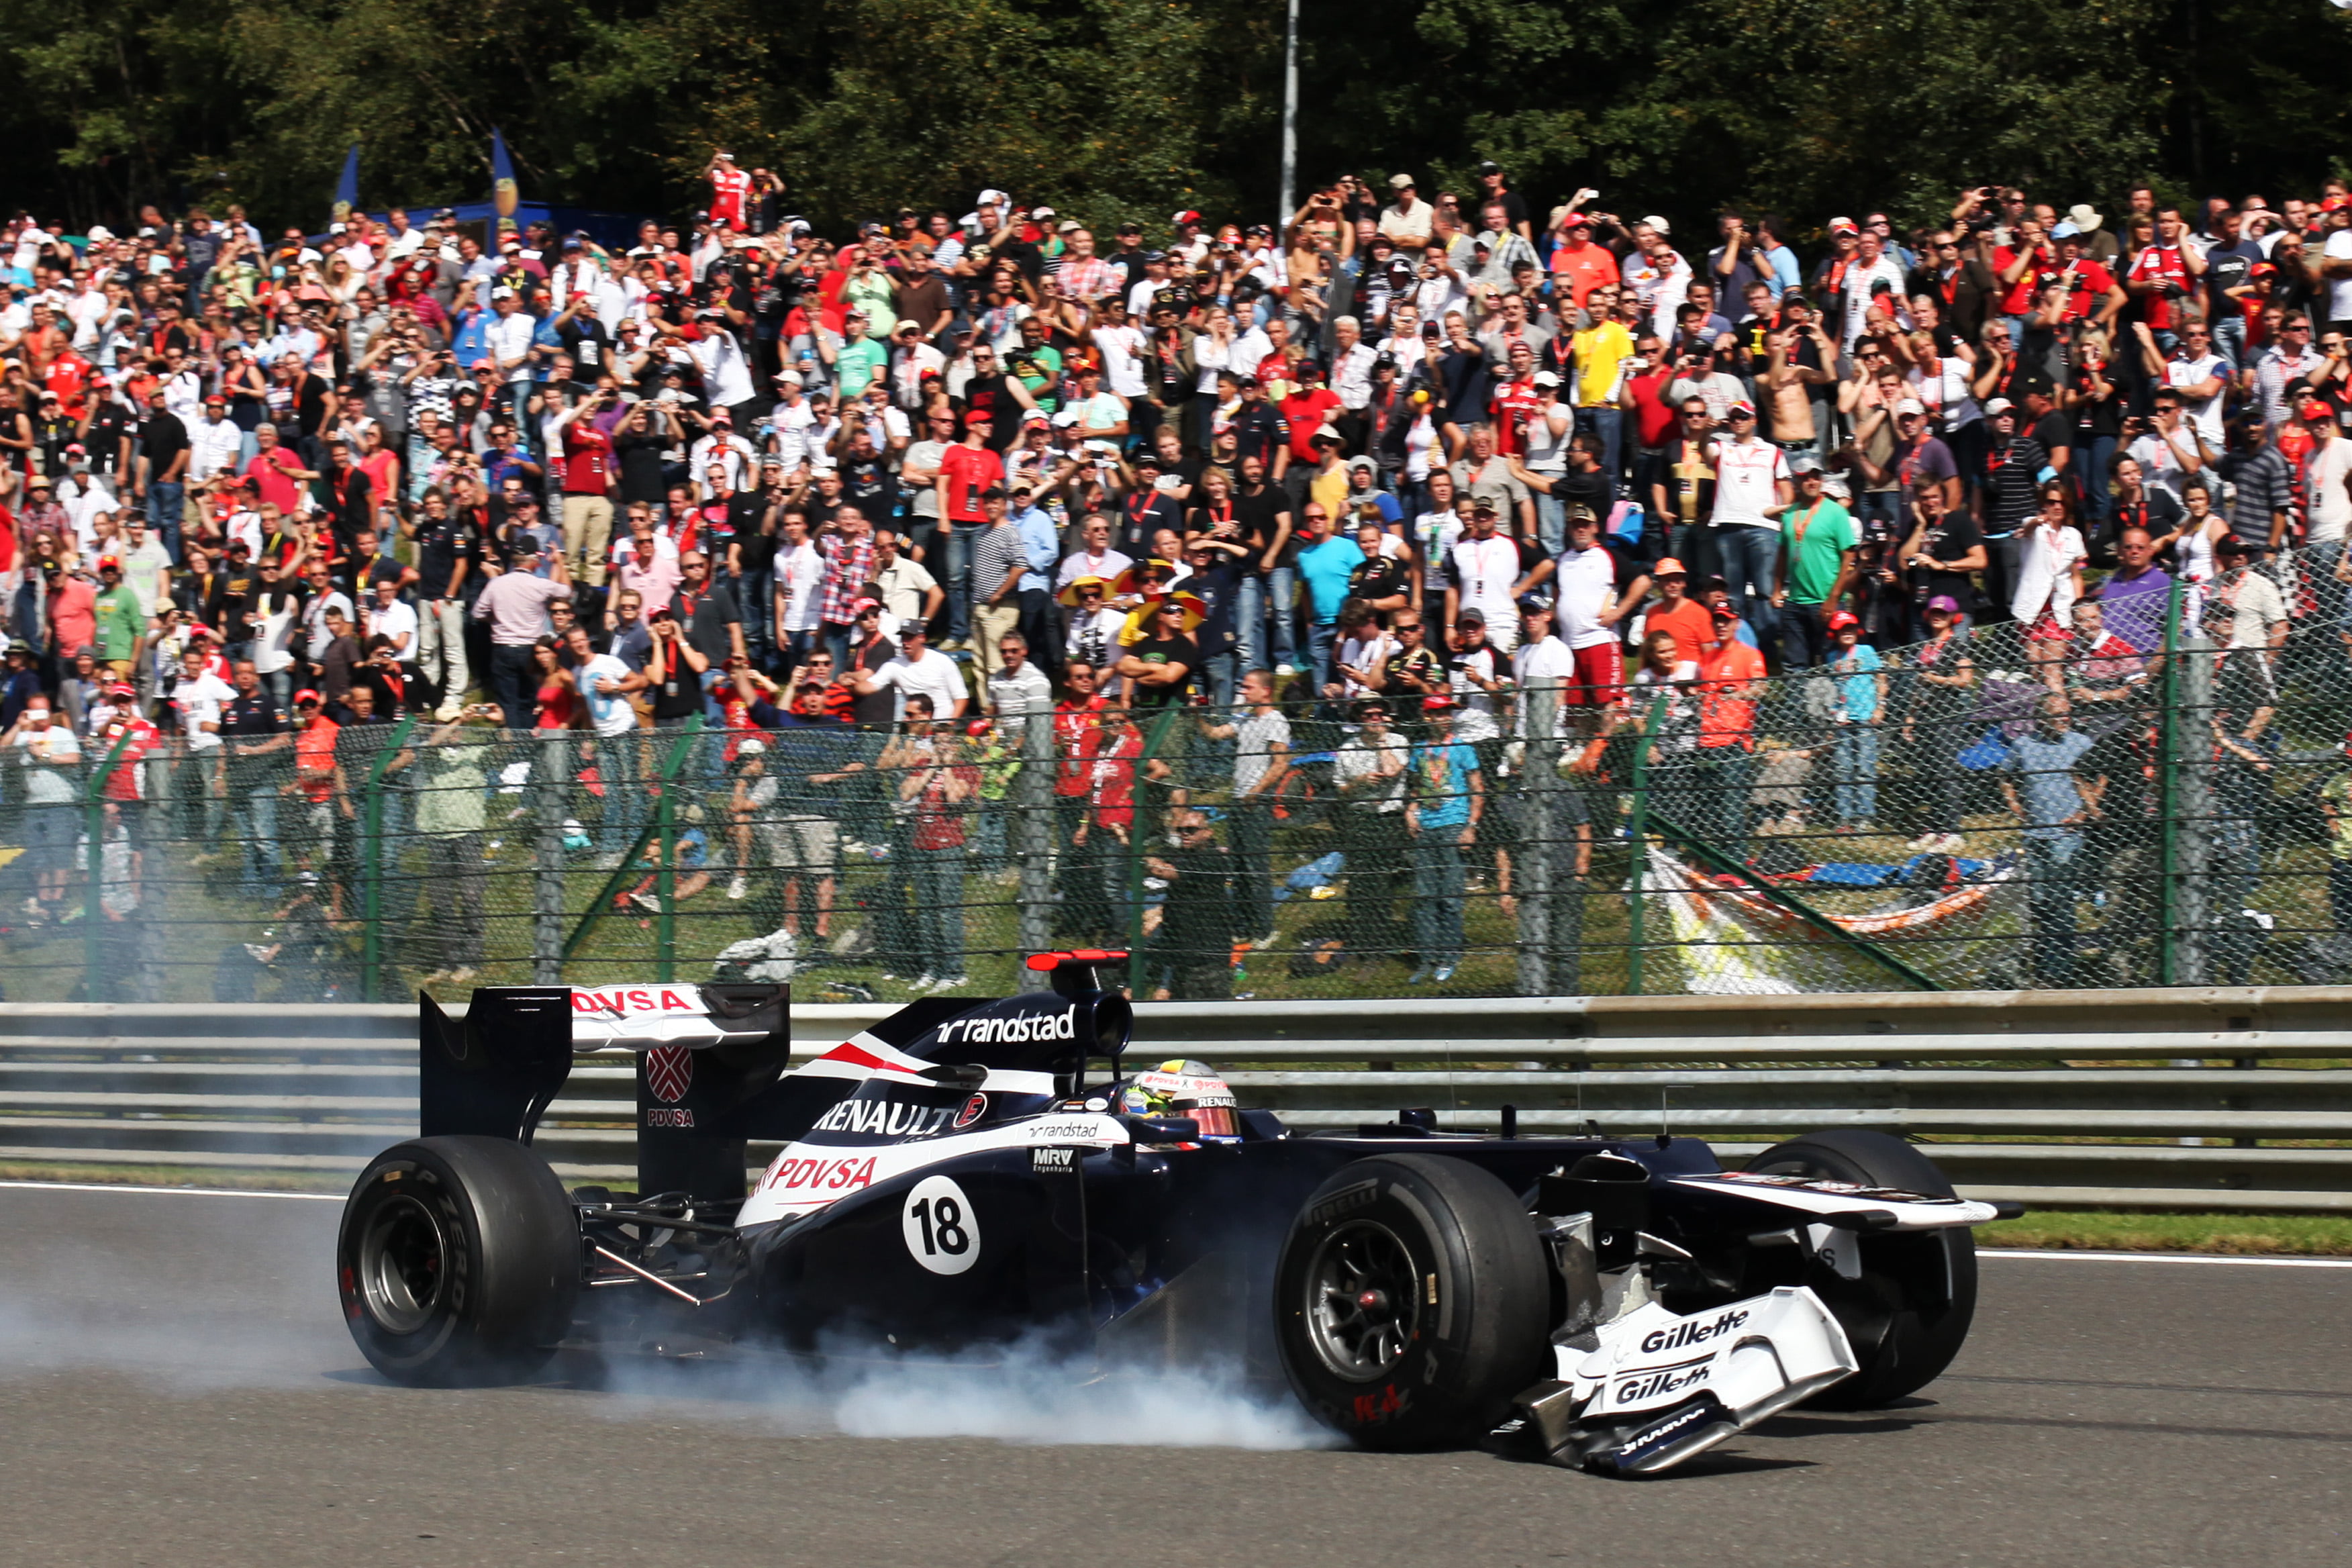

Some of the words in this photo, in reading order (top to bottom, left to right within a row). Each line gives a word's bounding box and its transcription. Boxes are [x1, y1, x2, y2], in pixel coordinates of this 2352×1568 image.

[963, 1003, 1075, 1043] randstad
[647, 1109, 695, 1128] PDVSA
[812, 1099, 957, 1136] RENAULT
[1042, 1122, 1099, 1138] randstad
[1033, 1165, 1073, 1173] Engenharia
[1034, 1148, 1074, 1165] MRV
[768, 1157, 878, 1189] PDVSA
[912, 1196, 970, 1255] 18
[1641, 1310, 1749, 1353] Gillette
